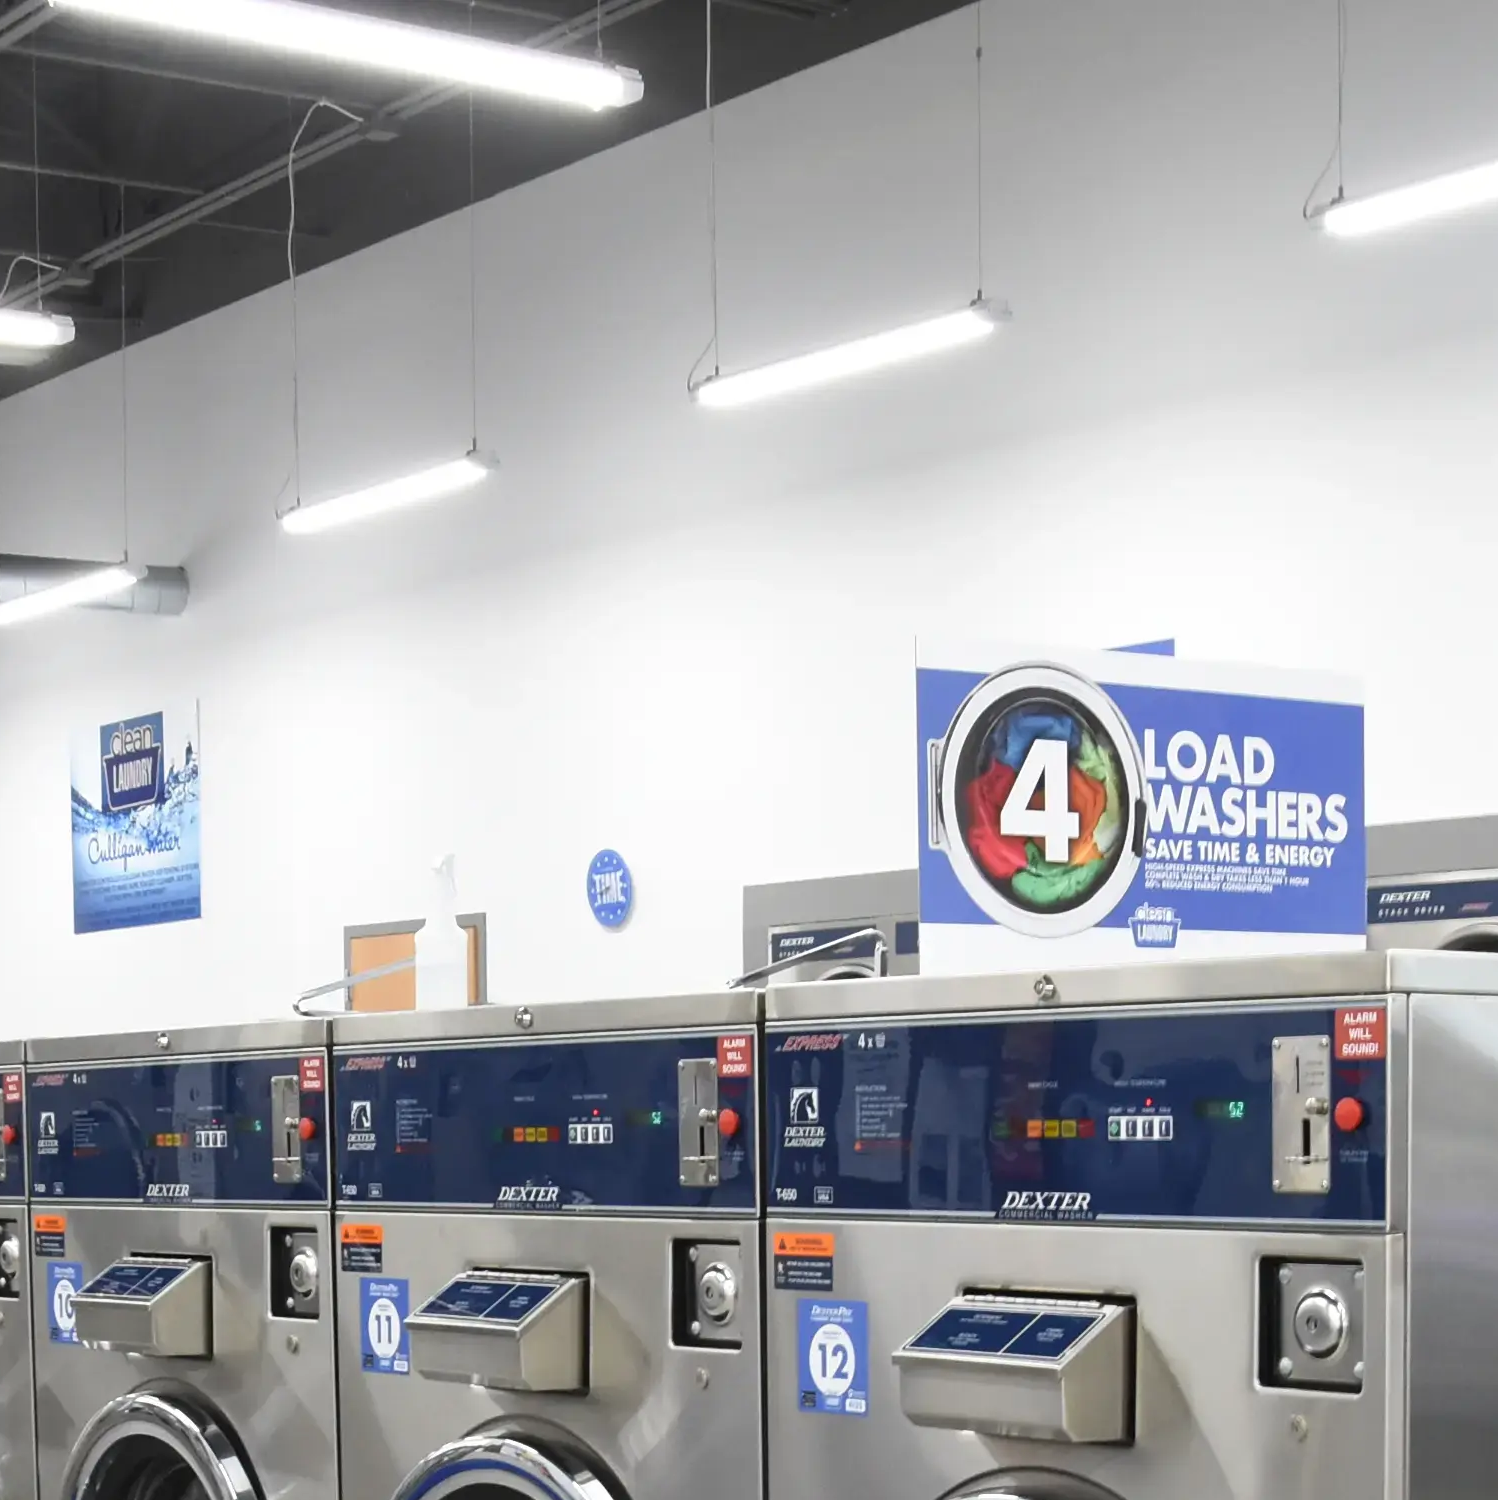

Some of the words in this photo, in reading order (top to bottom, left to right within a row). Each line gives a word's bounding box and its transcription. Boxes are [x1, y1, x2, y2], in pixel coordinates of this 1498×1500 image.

[111, 723, 153, 757] clean
[1144, 728, 1275, 787] LOAD
[113, 756, 153, 794] LAUNDRY
[999, 739, 1080, 863] 4
[1144, 784, 1348, 845] WASHERS
[87, 831, 146, 873] Culligan
[1144, 838, 1193, 861] SAVE
[1197, 841, 1241, 864] TIME
[1245, 842, 1260, 864] &
[1265, 843, 1336, 868] ENERGY
[1181, 872, 1203, 881] WASH
[591, 868, 626, 908] TIME
[1379, 889, 1432, 905] DEXTER
[1135, 901, 1176, 922] clean
[1343, 1011, 1378, 1025] ALARM
[1348, 1027, 1372, 1040] WILL
[722, 1038, 746, 1049] ALARM
[781, 1034, 843, 1052] EXPRESS
[857, 1032, 866, 1049] 4
[1341, 1041, 1379, 1056] SOUND!
[726, 1050, 742, 1061] WILL
[722, 1063, 747, 1074] SOUND!
[784, 1126, 826, 1138] DEXTER
[783, 1137, 827, 1148] LAUNDRY
[145, 1183, 190, 1197] DEXTER
[498, 1185, 560, 1202] DEXTER
[776, 1187, 798, 1201] T-650
[1002, 1190, 1091, 1211] DEXTER
[998, 1209, 1055, 1221] COMMERCIAL
[1057, 1210, 1094, 1221] WASHER
[375, 1314, 392, 1345] 11
[817, 1343, 849, 1380] 12
